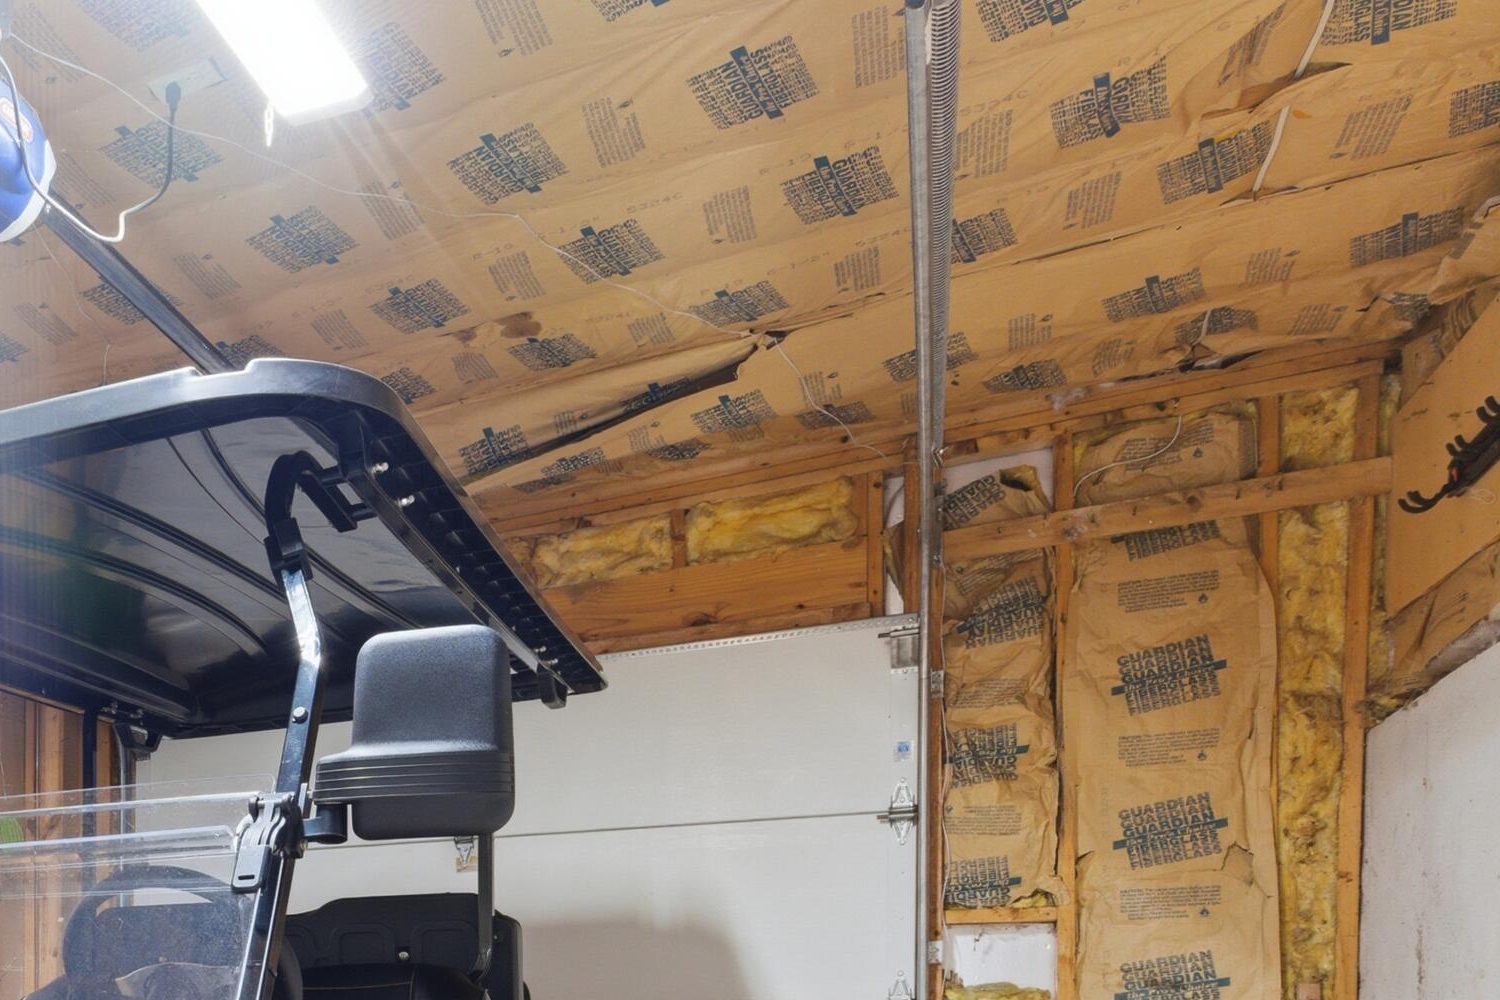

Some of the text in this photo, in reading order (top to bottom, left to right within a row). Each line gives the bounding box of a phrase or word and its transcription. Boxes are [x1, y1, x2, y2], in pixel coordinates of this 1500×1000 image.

[1117, 634, 1209, 666] GUARDIAN
[1120, 655, 1214, 684] GUARDIAN
[1125, 672, 1217, 700] FIBERGLASS
[1118, 791, 1209, 820] GUARDIAN
[1123, 812, 1214, 839] GUARDIAN
[1120, 949, 1212, 973] GUARDIAN
